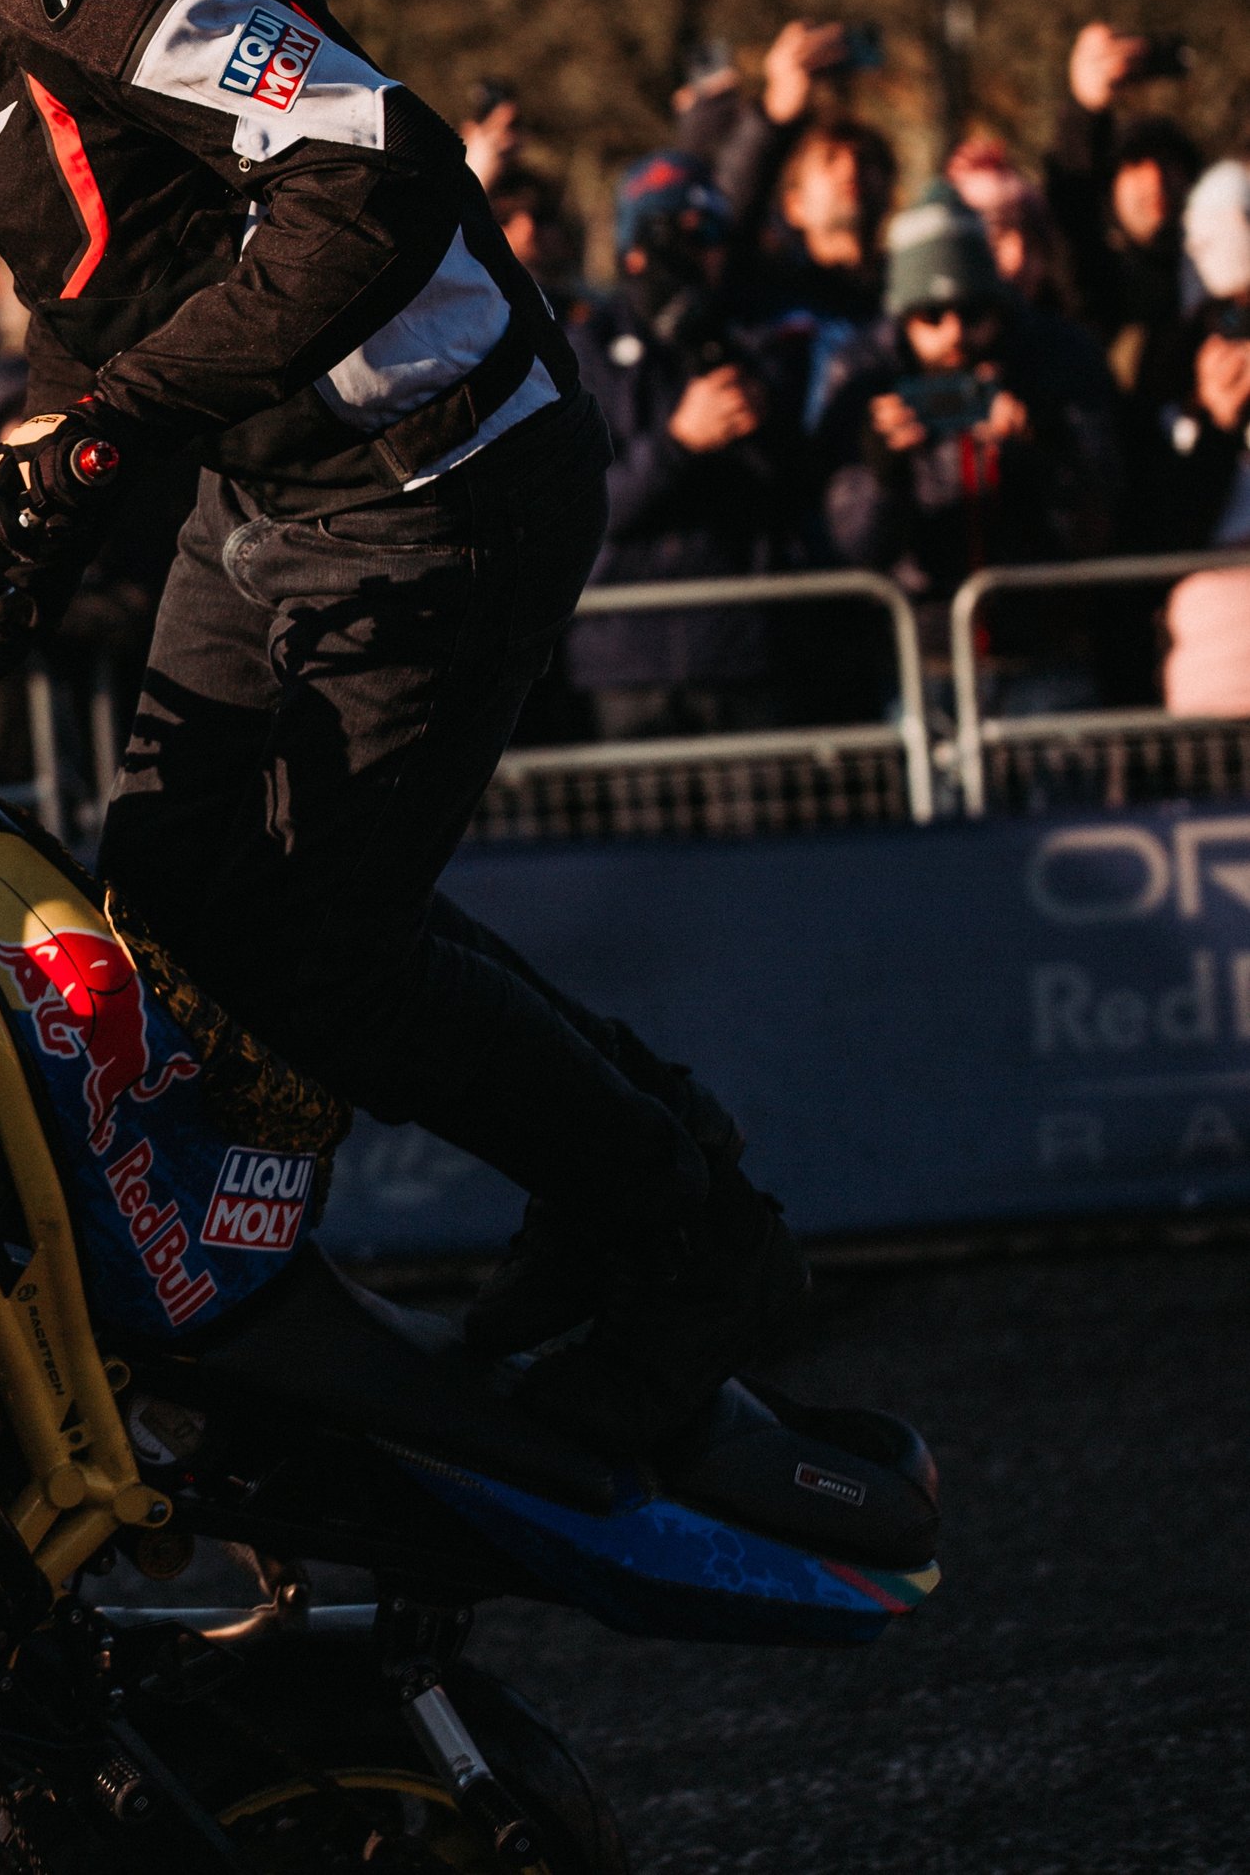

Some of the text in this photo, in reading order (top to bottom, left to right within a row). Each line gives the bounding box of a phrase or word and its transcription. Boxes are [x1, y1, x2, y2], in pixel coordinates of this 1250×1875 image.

[223, 13, 284, 93] LIQUI
[257, 27, 316, 106] MOLY
[222, 1153, 312, 1200] LIQUI
[208, 1197, 302, 1245] MOLY
[28, 1305, 66, 1396] RACETECH
